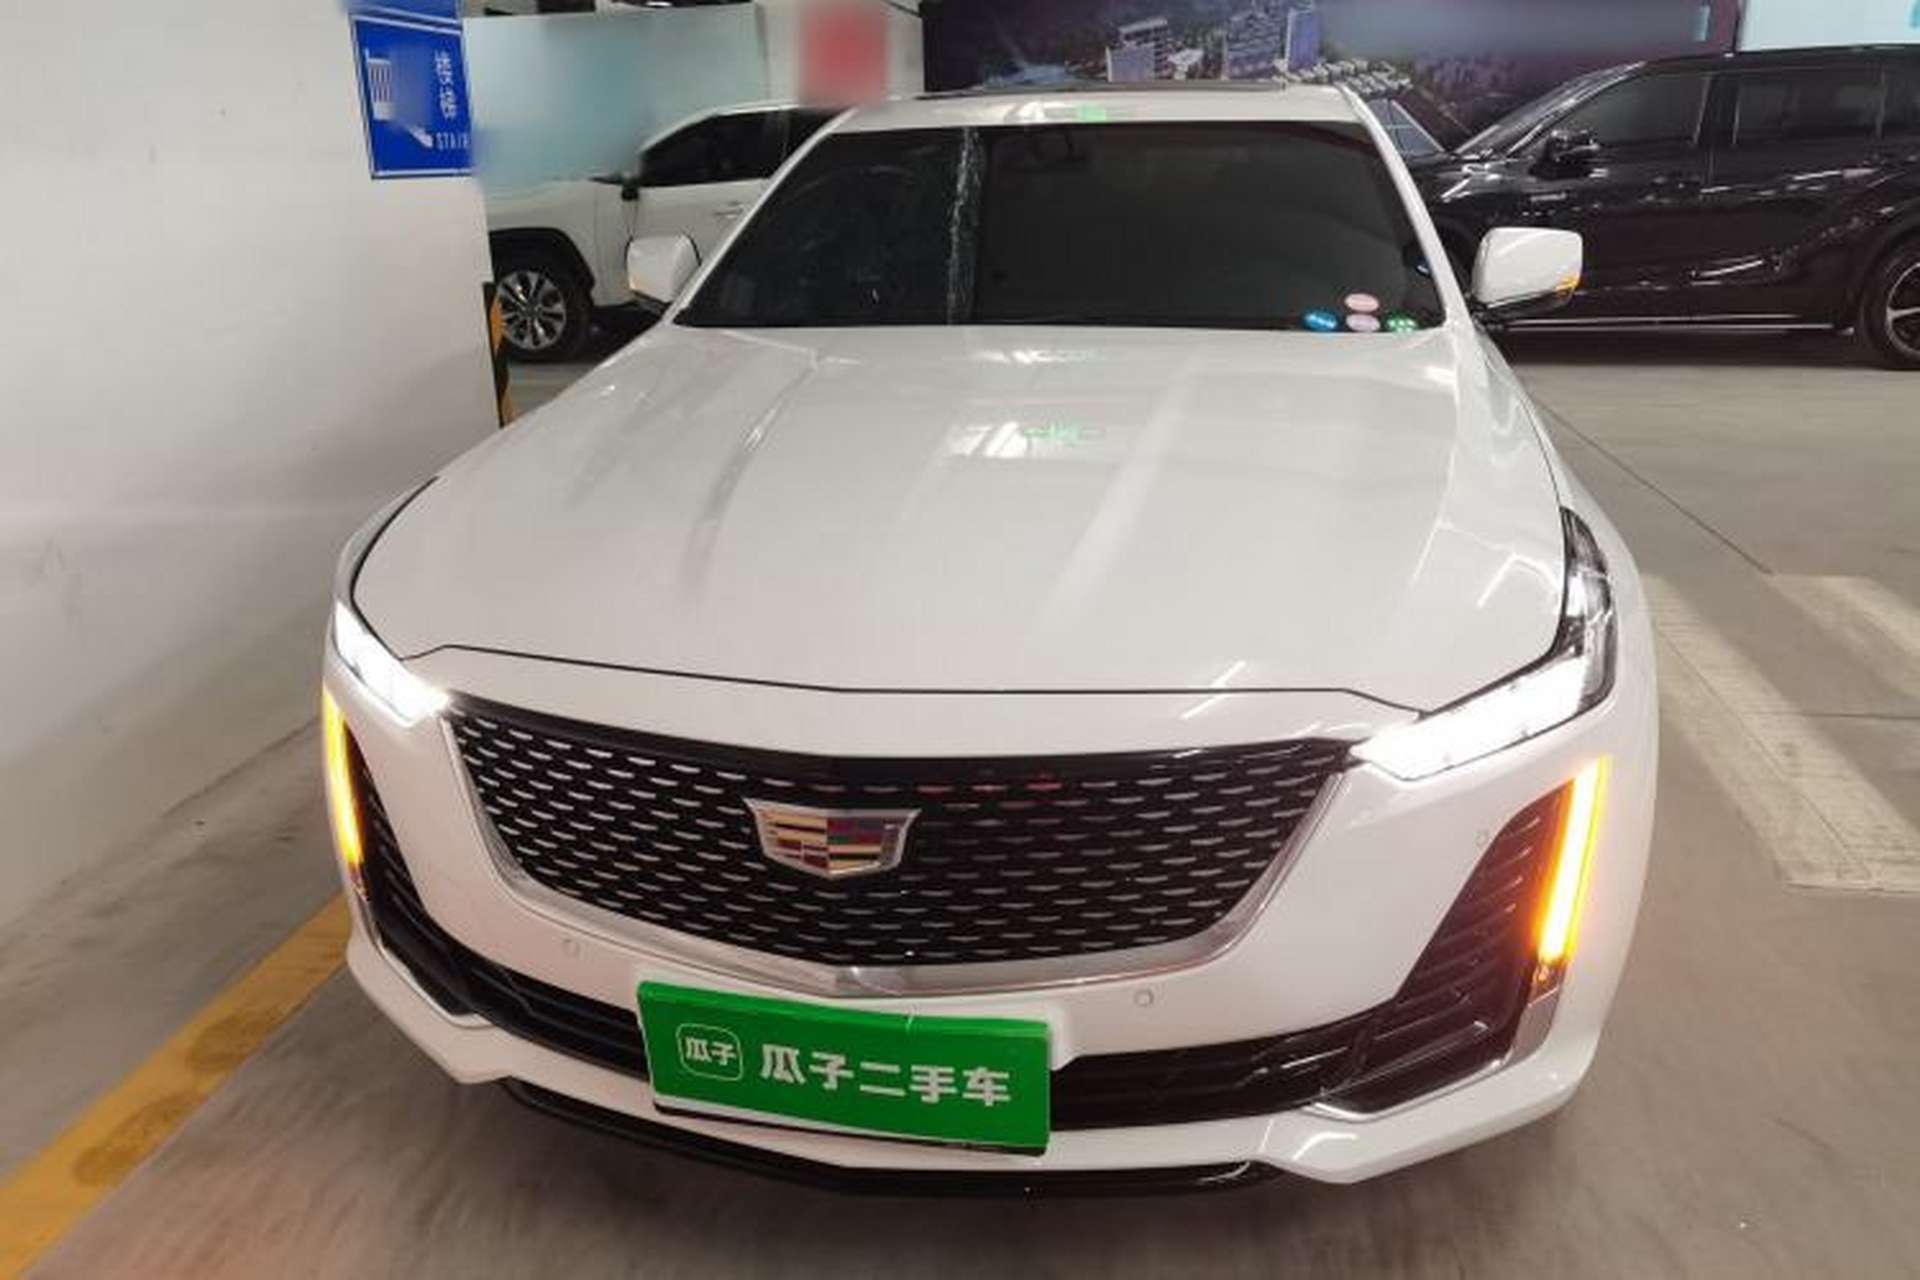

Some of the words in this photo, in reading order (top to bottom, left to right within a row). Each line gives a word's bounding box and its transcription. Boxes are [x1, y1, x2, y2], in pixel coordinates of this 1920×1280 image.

[685, 1037, 736, 1066] 瓜子
[760, 1044, 1011, 1107] 瓜子二手车
